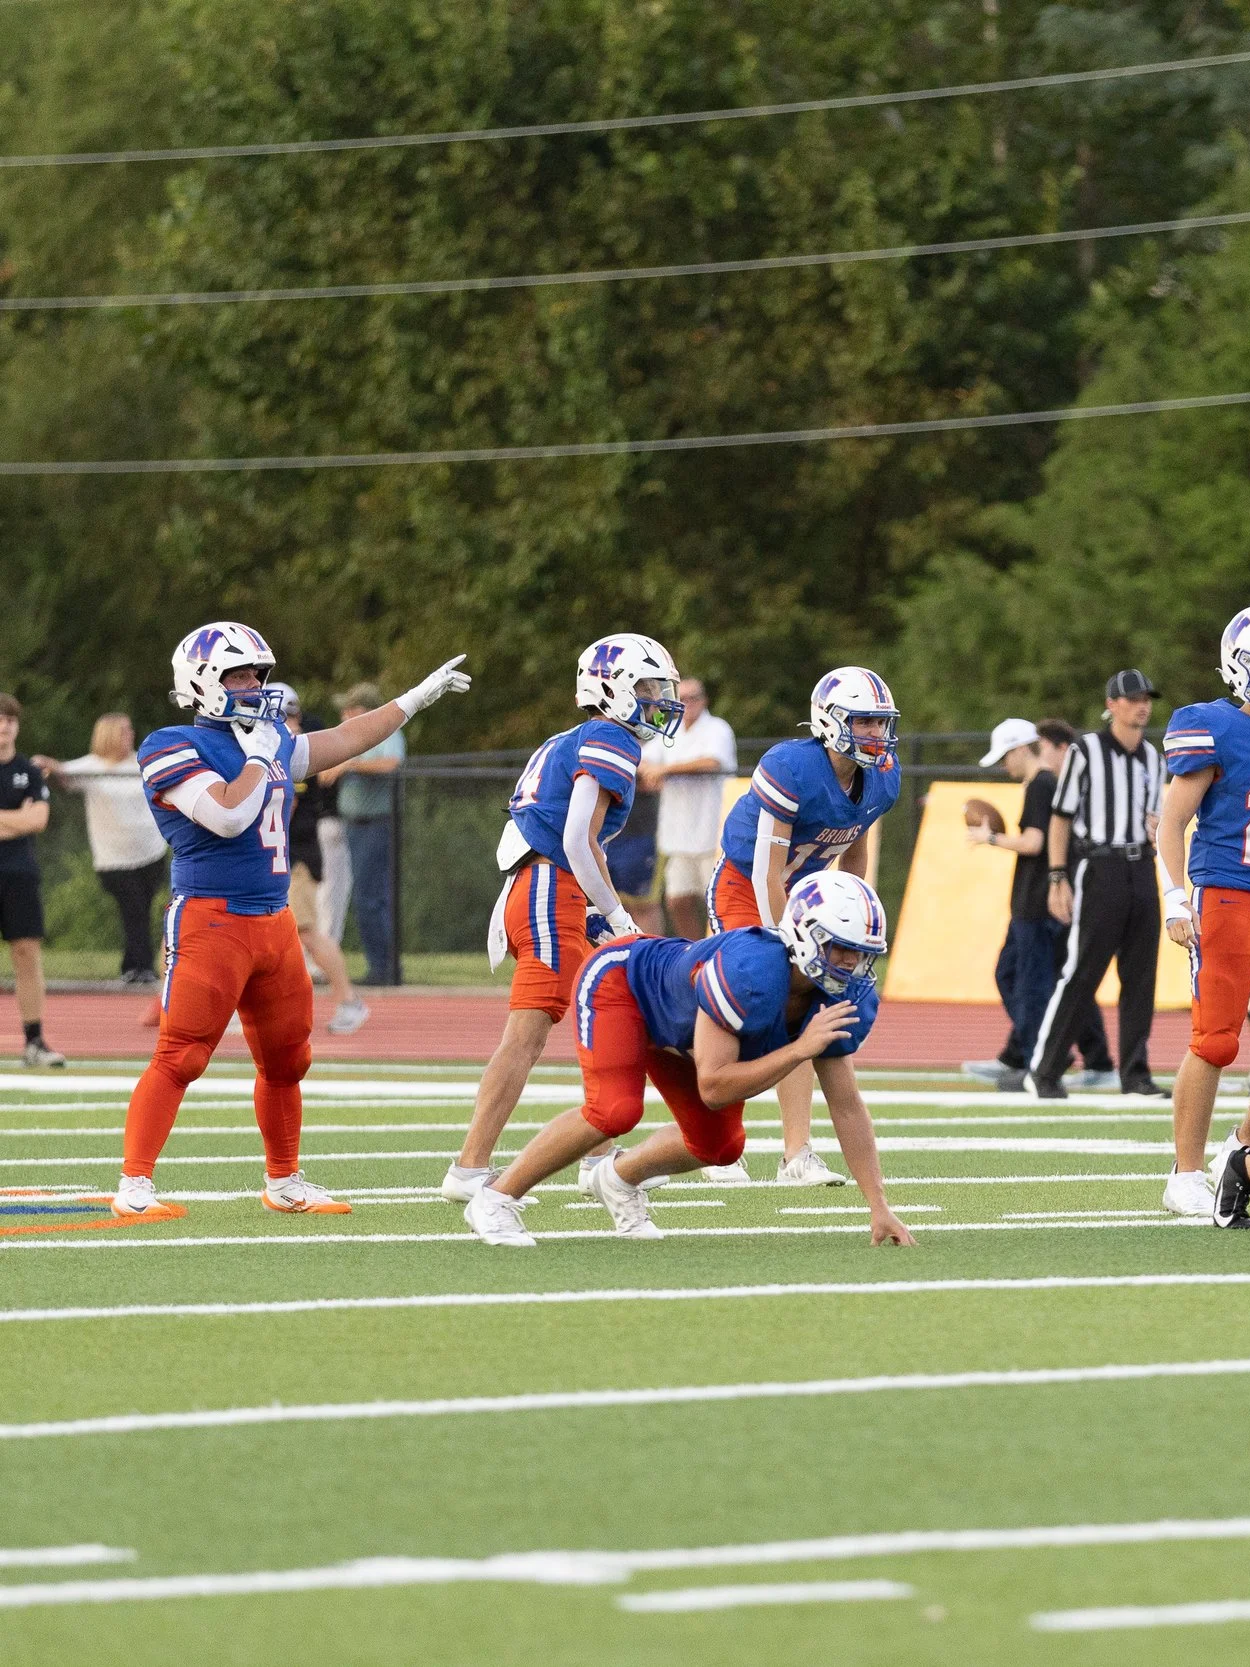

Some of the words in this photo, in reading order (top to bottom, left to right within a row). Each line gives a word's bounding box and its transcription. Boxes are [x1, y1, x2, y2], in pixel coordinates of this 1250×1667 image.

[187, 628, 223, 662] N
[588, 644, 625, 680] N
[258, 786, 288, 874] 4
[815, 824, 862, 844] BRUINS
